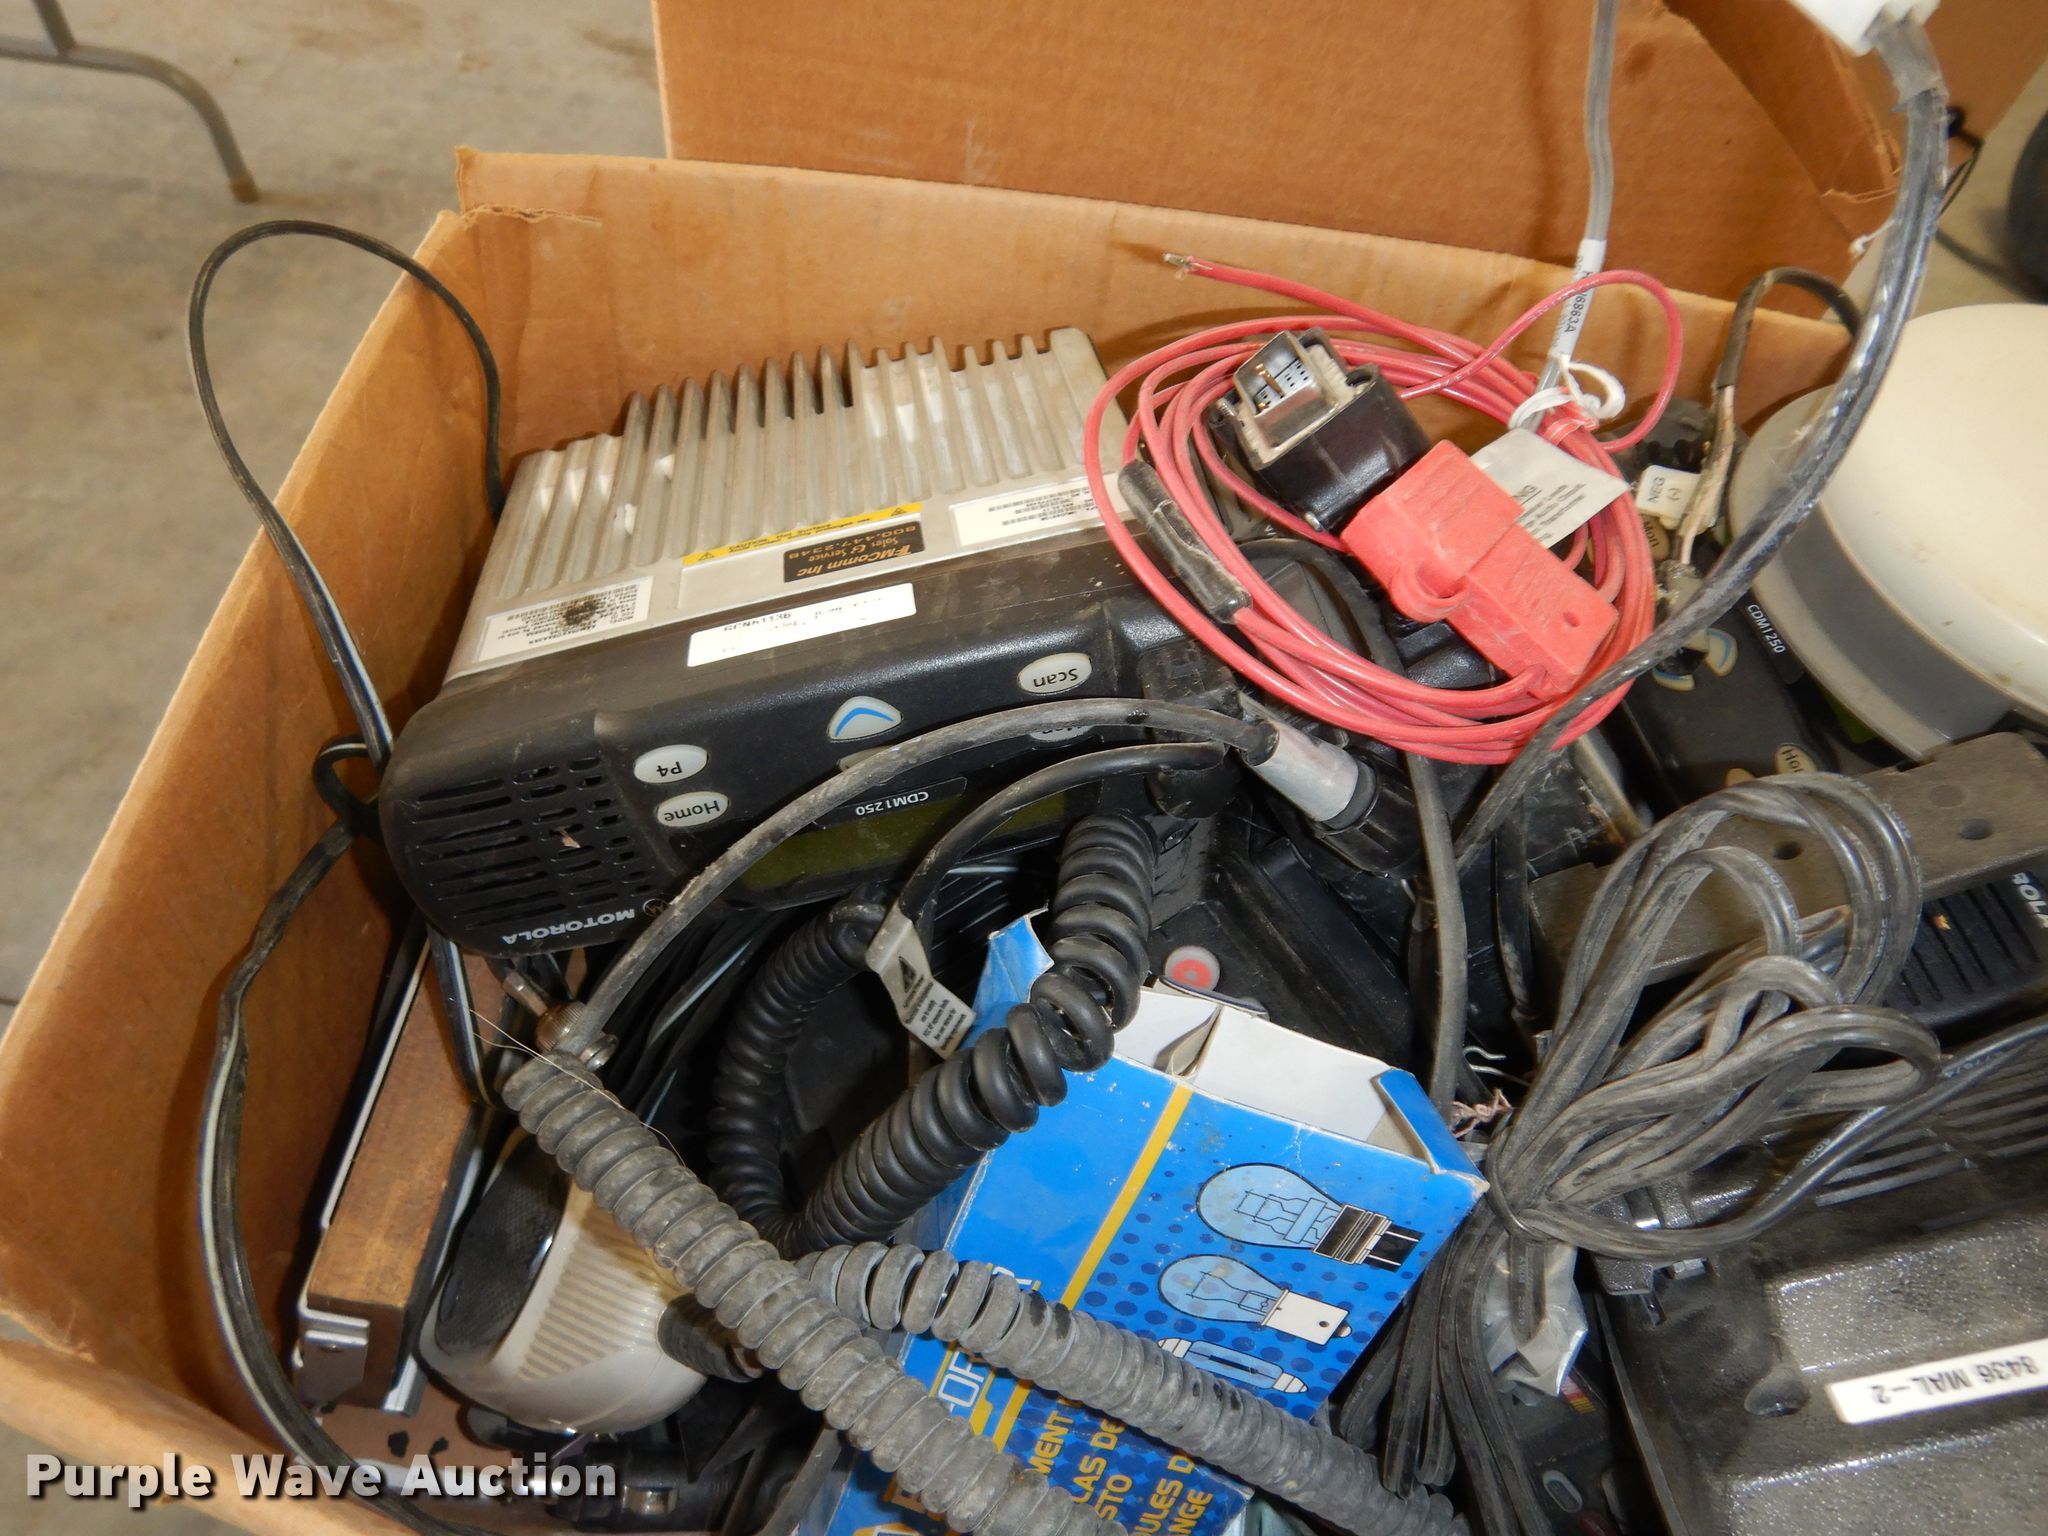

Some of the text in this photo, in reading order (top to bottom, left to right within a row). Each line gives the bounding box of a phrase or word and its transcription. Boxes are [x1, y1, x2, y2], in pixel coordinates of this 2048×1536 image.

[1564, 271, 1594, 333] H6863A
[807, 548, 847, 564] Service
[870, 535, 898, 548] Sales
[795, 563, 824, 577] Inc
[1746, 603, 1787, 655] CDM1250
[1031, 667, 1079, 689] Scan
[656, 759, 684, 778] P4
[663, 799, 721, 823] Home
[855, 789, 930, 816] CDM1250
[502, 907, 635, 946] MOTOROLA
[1029, 1410, 1074, 1474] MENT
[1071, 1455, 1108, 1503] LAS
[1094, 1474, 1133, 1520] STO
[1134, 1478, 1184, 1536] ULES
[1168, 1489, 1214, 1536] NGE
